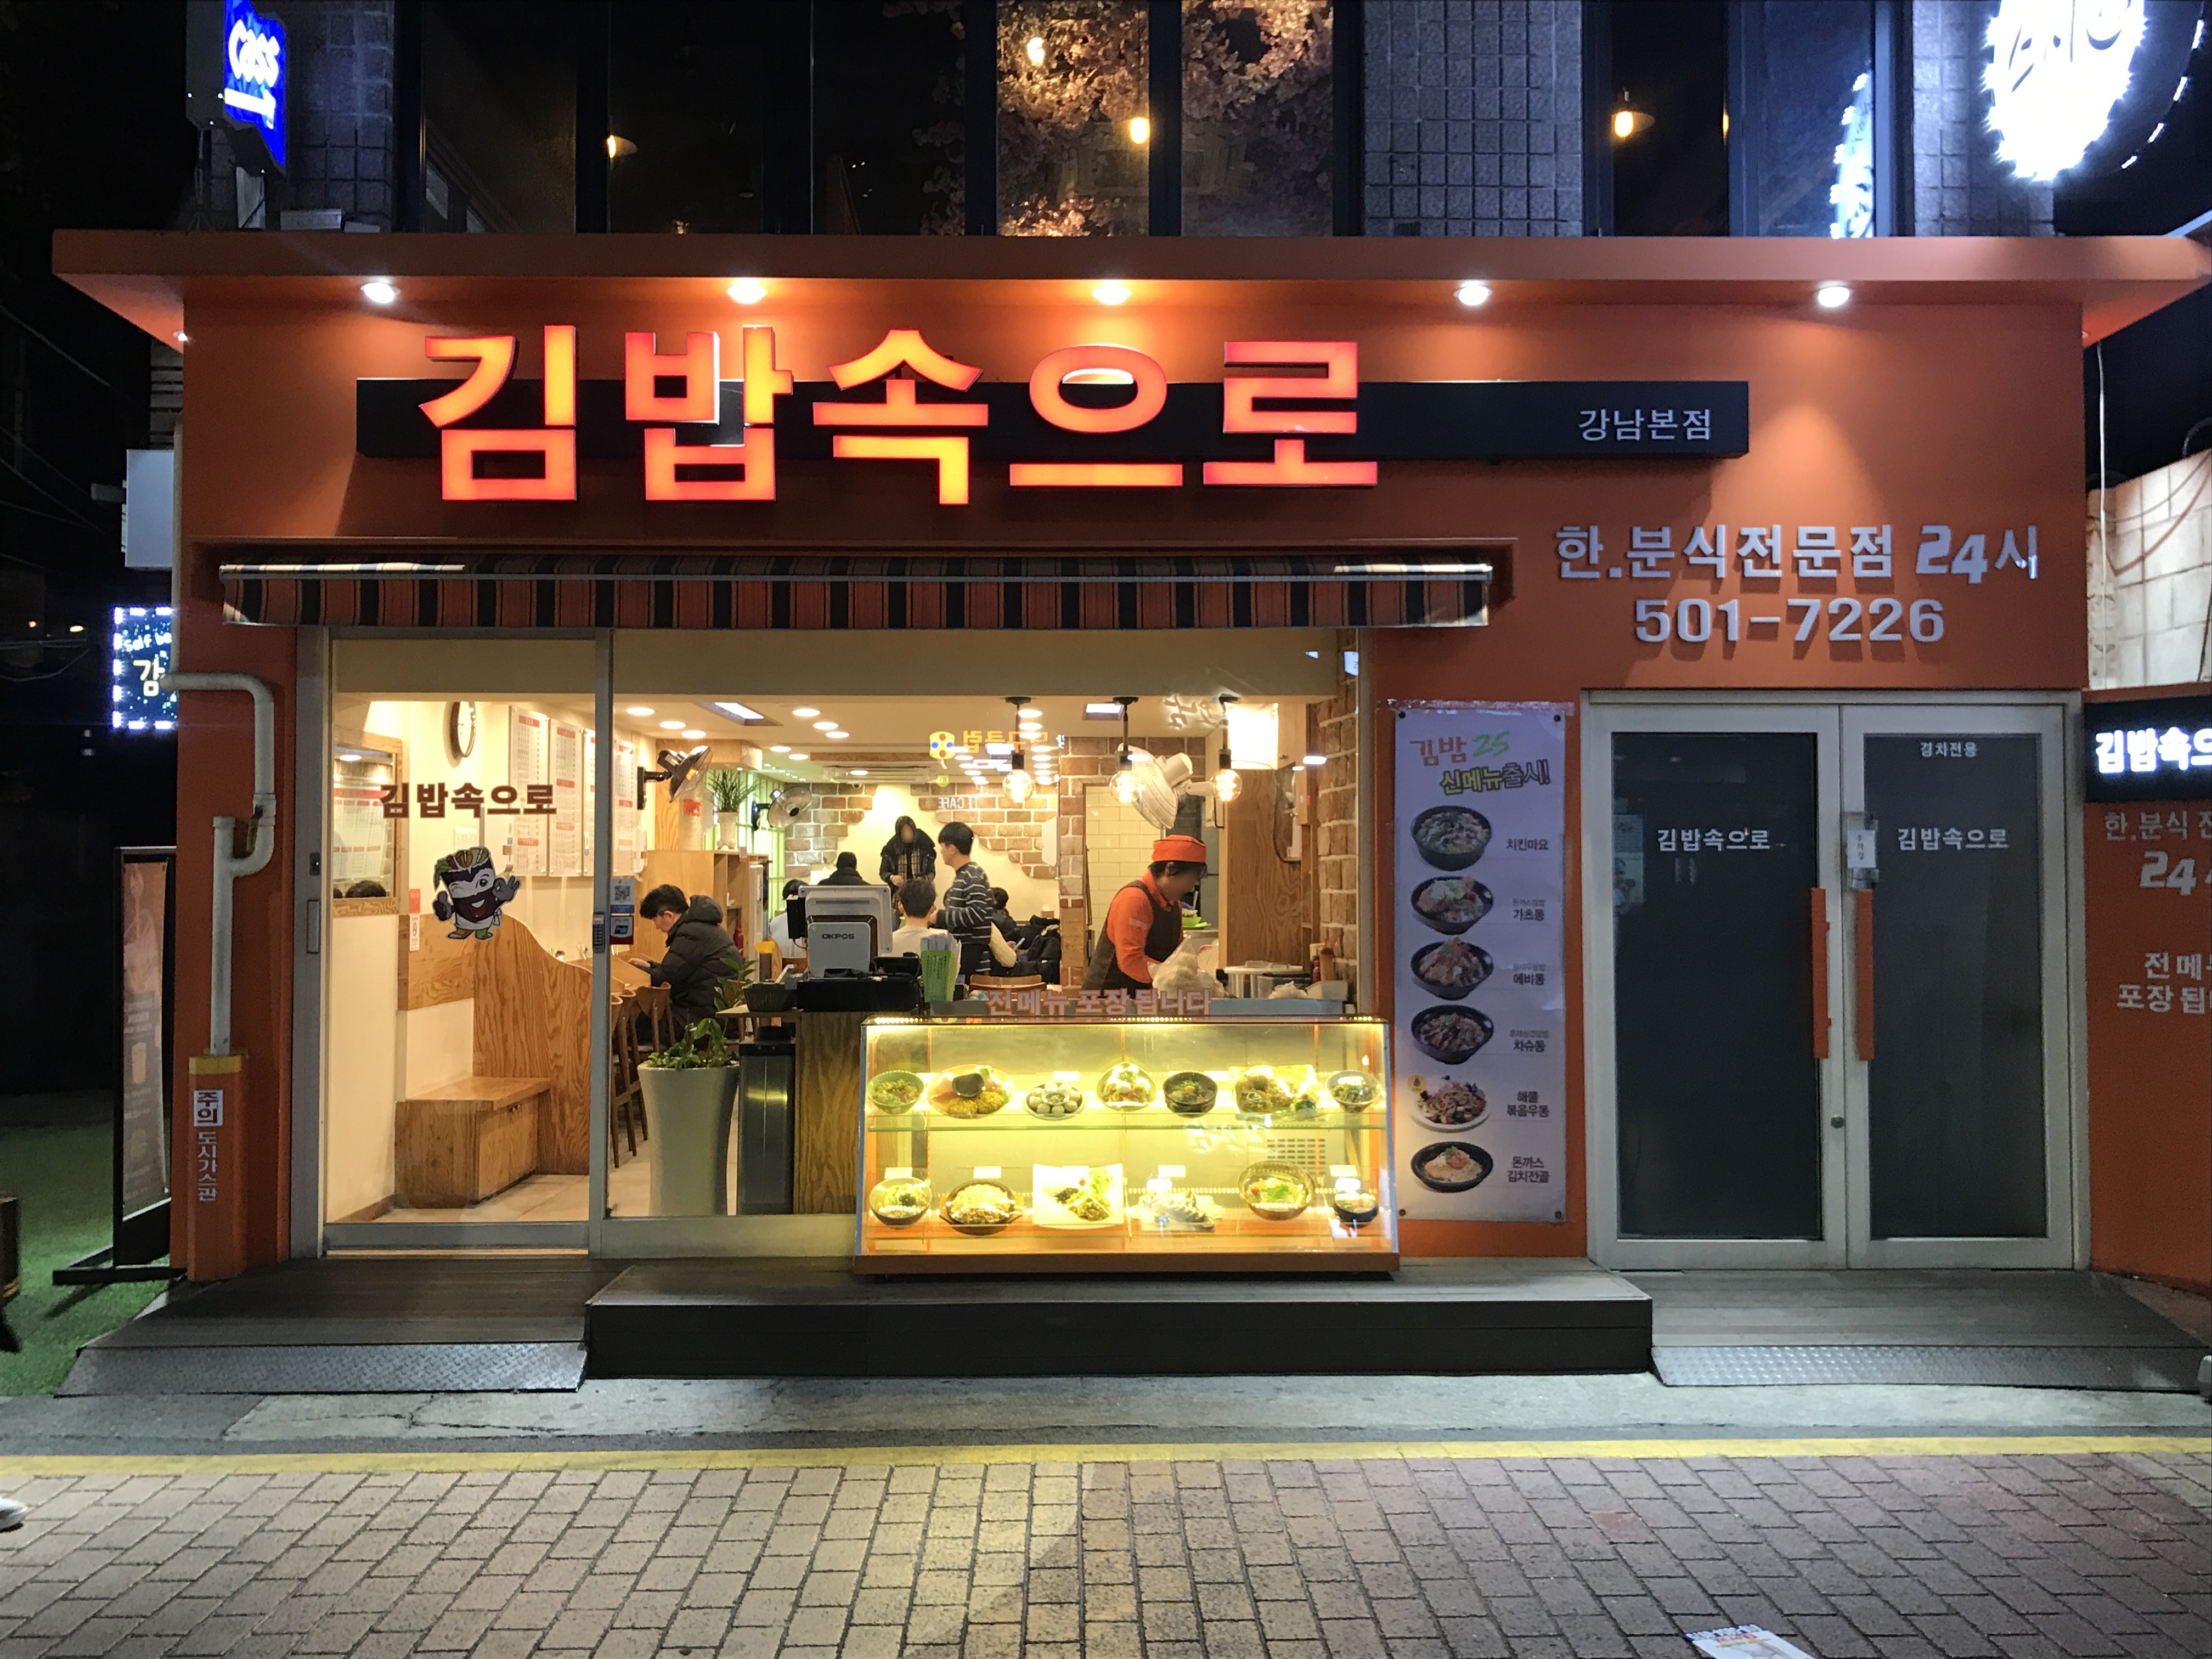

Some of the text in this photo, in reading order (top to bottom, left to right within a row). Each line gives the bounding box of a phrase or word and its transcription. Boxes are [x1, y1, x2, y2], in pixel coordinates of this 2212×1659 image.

[228, 19, 280, 88] Cass
[418, 324, 1378, 505] 김밥속으로
[1578, 409, 1712, 442] 강남본점
[1555, 523, 2038, 583] 한.분식전문점 24시
[1634, 597, 1944, 643] 501-7226
[133, 657, 165, 697] 감
[379, 782, 557, 819] 김밥속으로
[1506, 838, 1549, 851] 치킨마요
[1657, 828, 1770, 852] 김밥속으로
[1898, 827, 2009, 851] 김밥속으로
[2140, 850, 2212, 896] 24
[1513, 909, 1545, 922] 가츠동
[1513, 973, 1545, 986] 에비동
[2144, 952, 2212, 981] 전메
[988, 989, 1070, 1016] 전메뉴
[2180, 986, 2212, 1014] 됩
[1513, 1040, 1546, 1053] 차슈동
[197, 1091, 218, 1124] 주의
[1506, 1104, 1549, 1118] 볶음우동
[1517, 1091, 1539, 1104] 해물
[198, 1131, 217, 1201] 도시가스관
[1512, 1155, 1544, 1169] 돈까스
[1507, 1170, 1550, 1183] 김치전골
